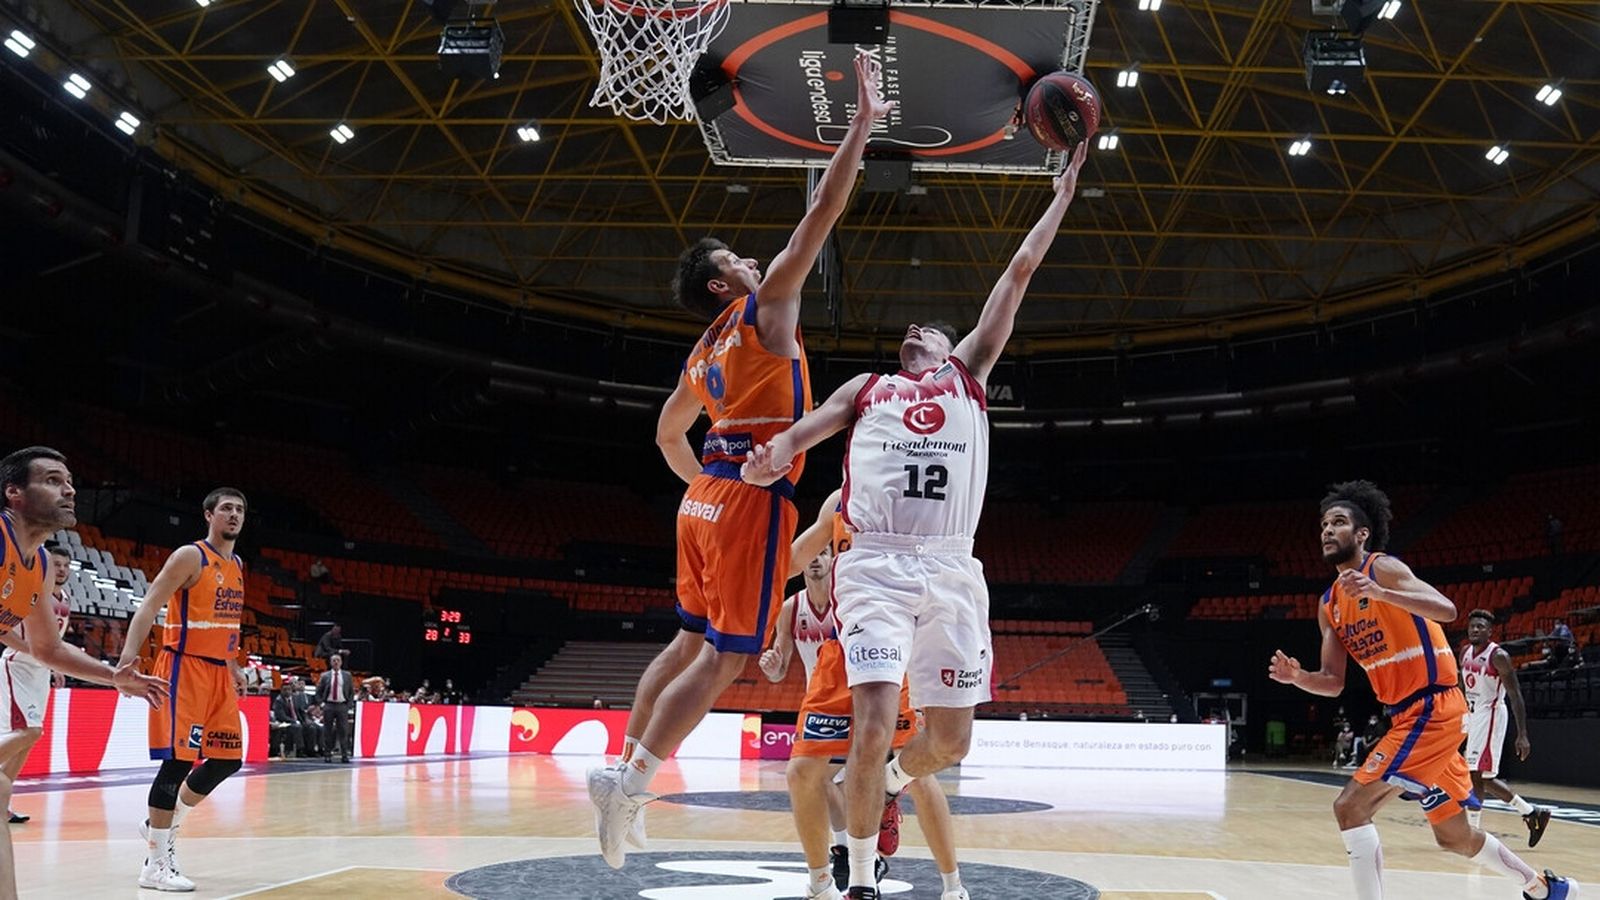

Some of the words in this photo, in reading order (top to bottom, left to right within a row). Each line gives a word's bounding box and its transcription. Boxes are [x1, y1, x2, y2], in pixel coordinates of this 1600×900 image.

[886, 69, 900, 95] FASE
[882, 436, 967, 454] Casademont
[903, 464, 949, 501] 12
[425, 628, 439, 641] 28
[458, 631, 471, 644] 33
[807, 716, 849, 728] PULEVA
[977, 738, 1021, 749] Descubre
[1073, 740, 1123, 750] naturaleza
[1124, 742, 1136, 750] en
[1138, 741, 1169, 751] estado
[1171, 743, 1193, 753] puro
[1195, 743, 1212, 751] con
